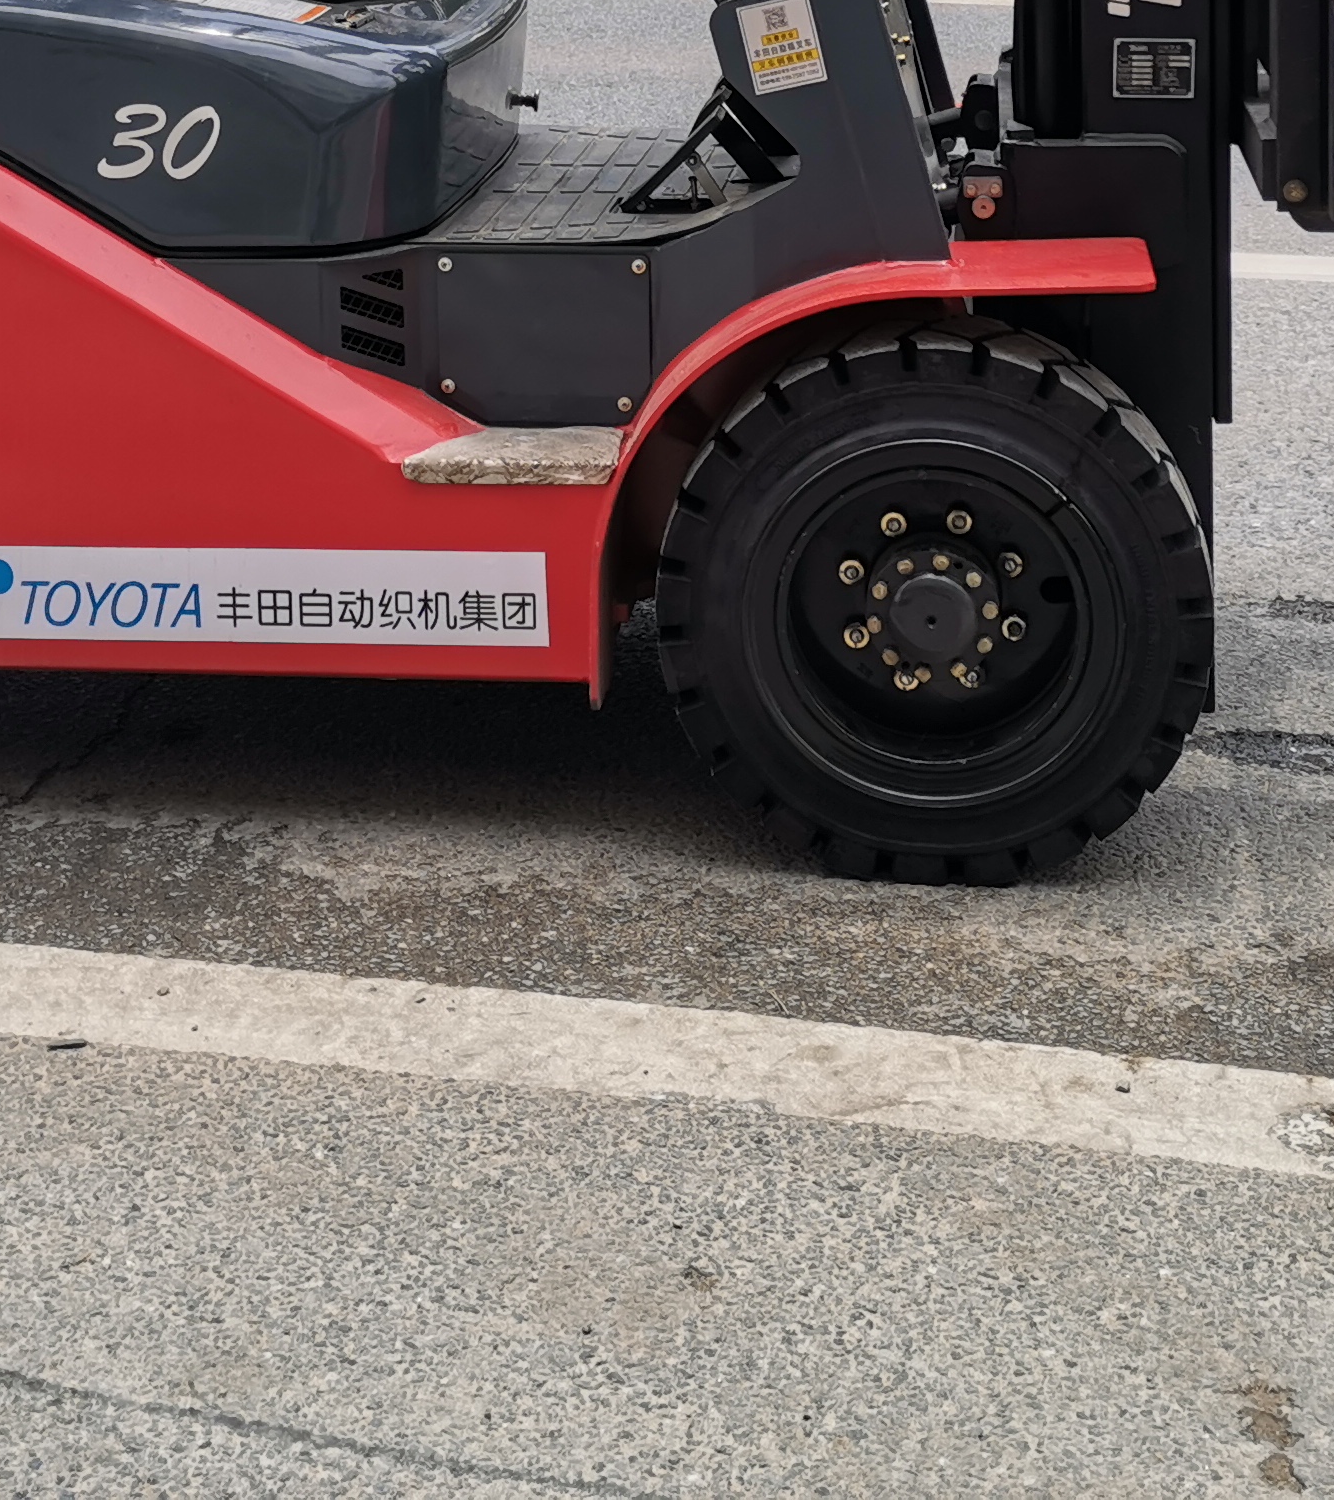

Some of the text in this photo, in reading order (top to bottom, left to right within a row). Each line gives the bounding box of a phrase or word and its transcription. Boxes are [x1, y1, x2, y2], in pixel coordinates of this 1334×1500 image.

[97, 103, 221, 180] 30
[19, 581, 203, 629] TOYOTA
[216, 586, 537, 633] 丰田自动织机集团
